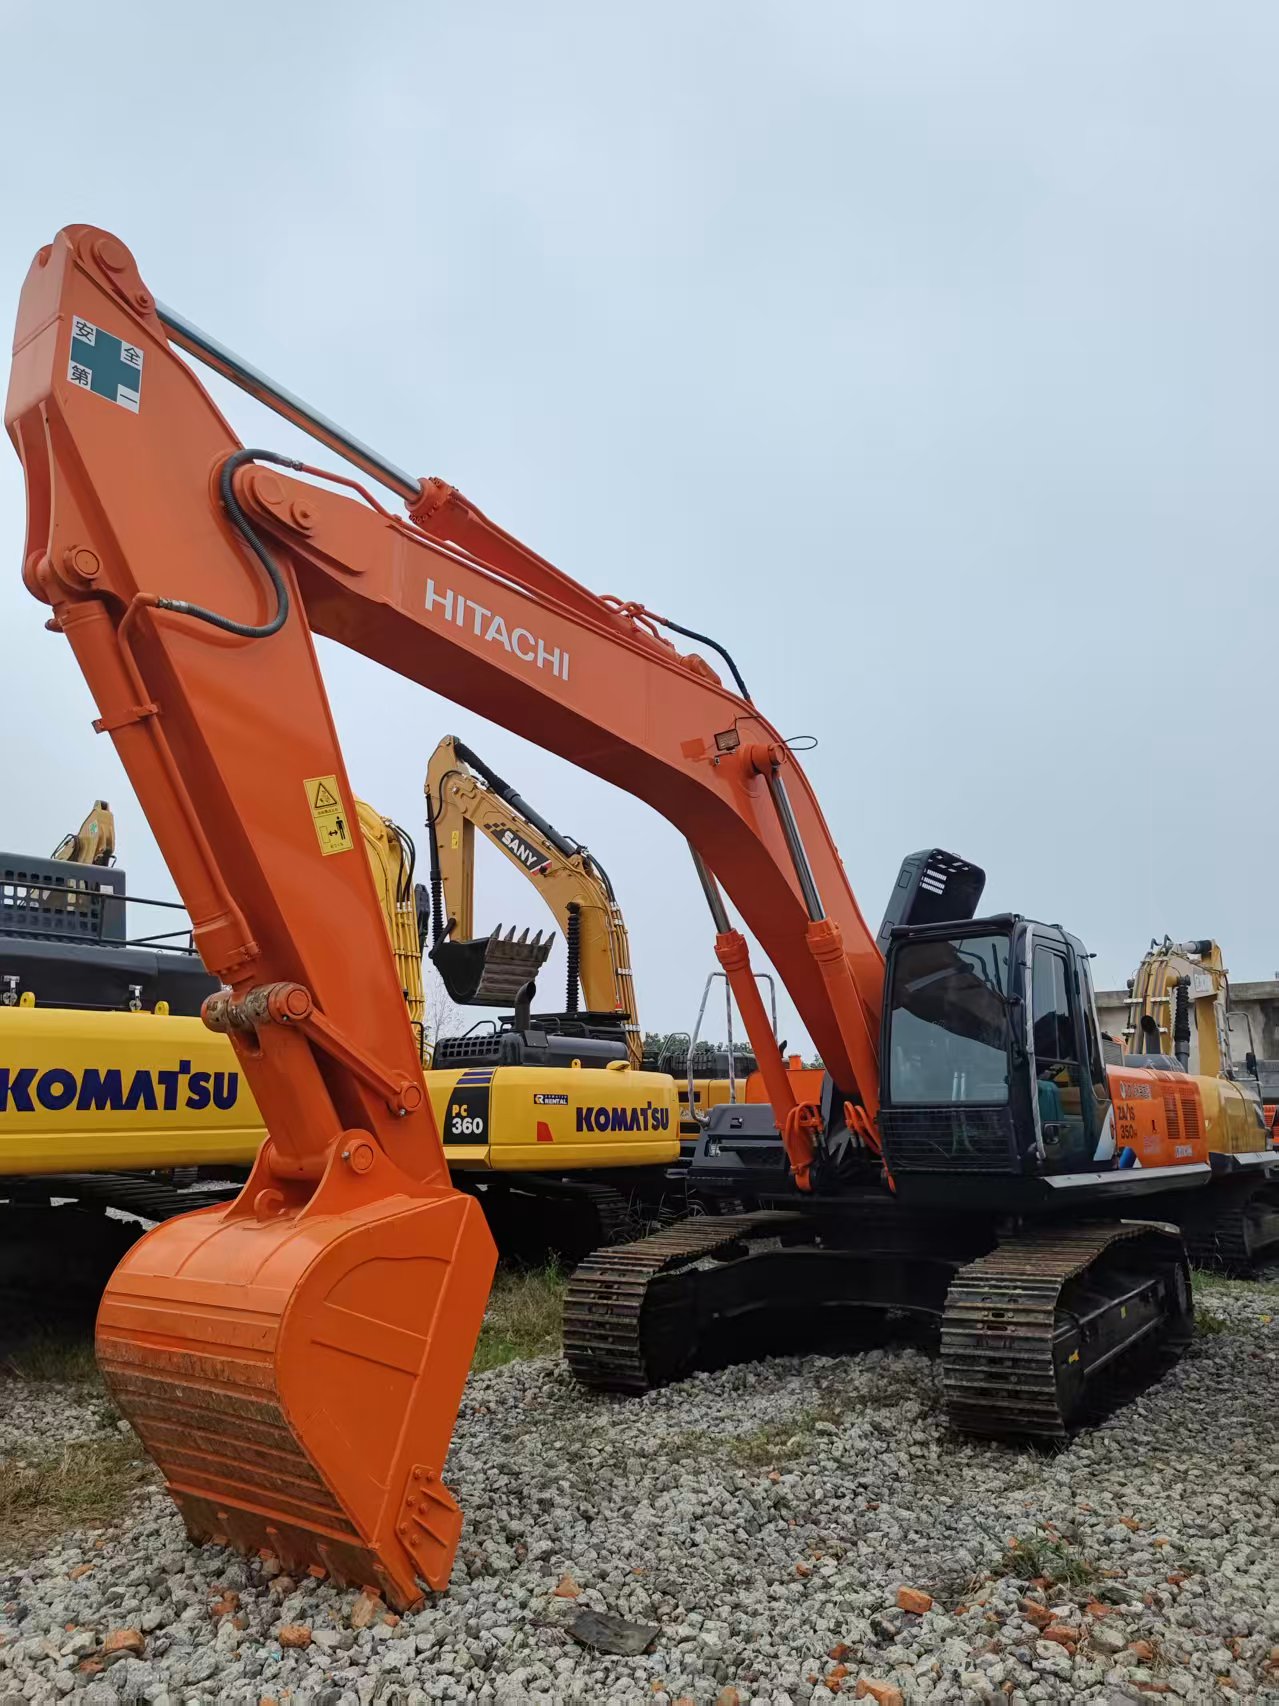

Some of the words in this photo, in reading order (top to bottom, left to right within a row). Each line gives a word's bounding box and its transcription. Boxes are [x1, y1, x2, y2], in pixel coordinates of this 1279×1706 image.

[425, 578, 570, 681] HITACHI
[501, 830, 537, 866] SANY
[0, 1060, 238, 1112] KOMATSU
[451, 1117, 484, 1134] 360
[452, 1104, 468, 1117] PC
[576, 1101, 669, 1132] KOMATSU
